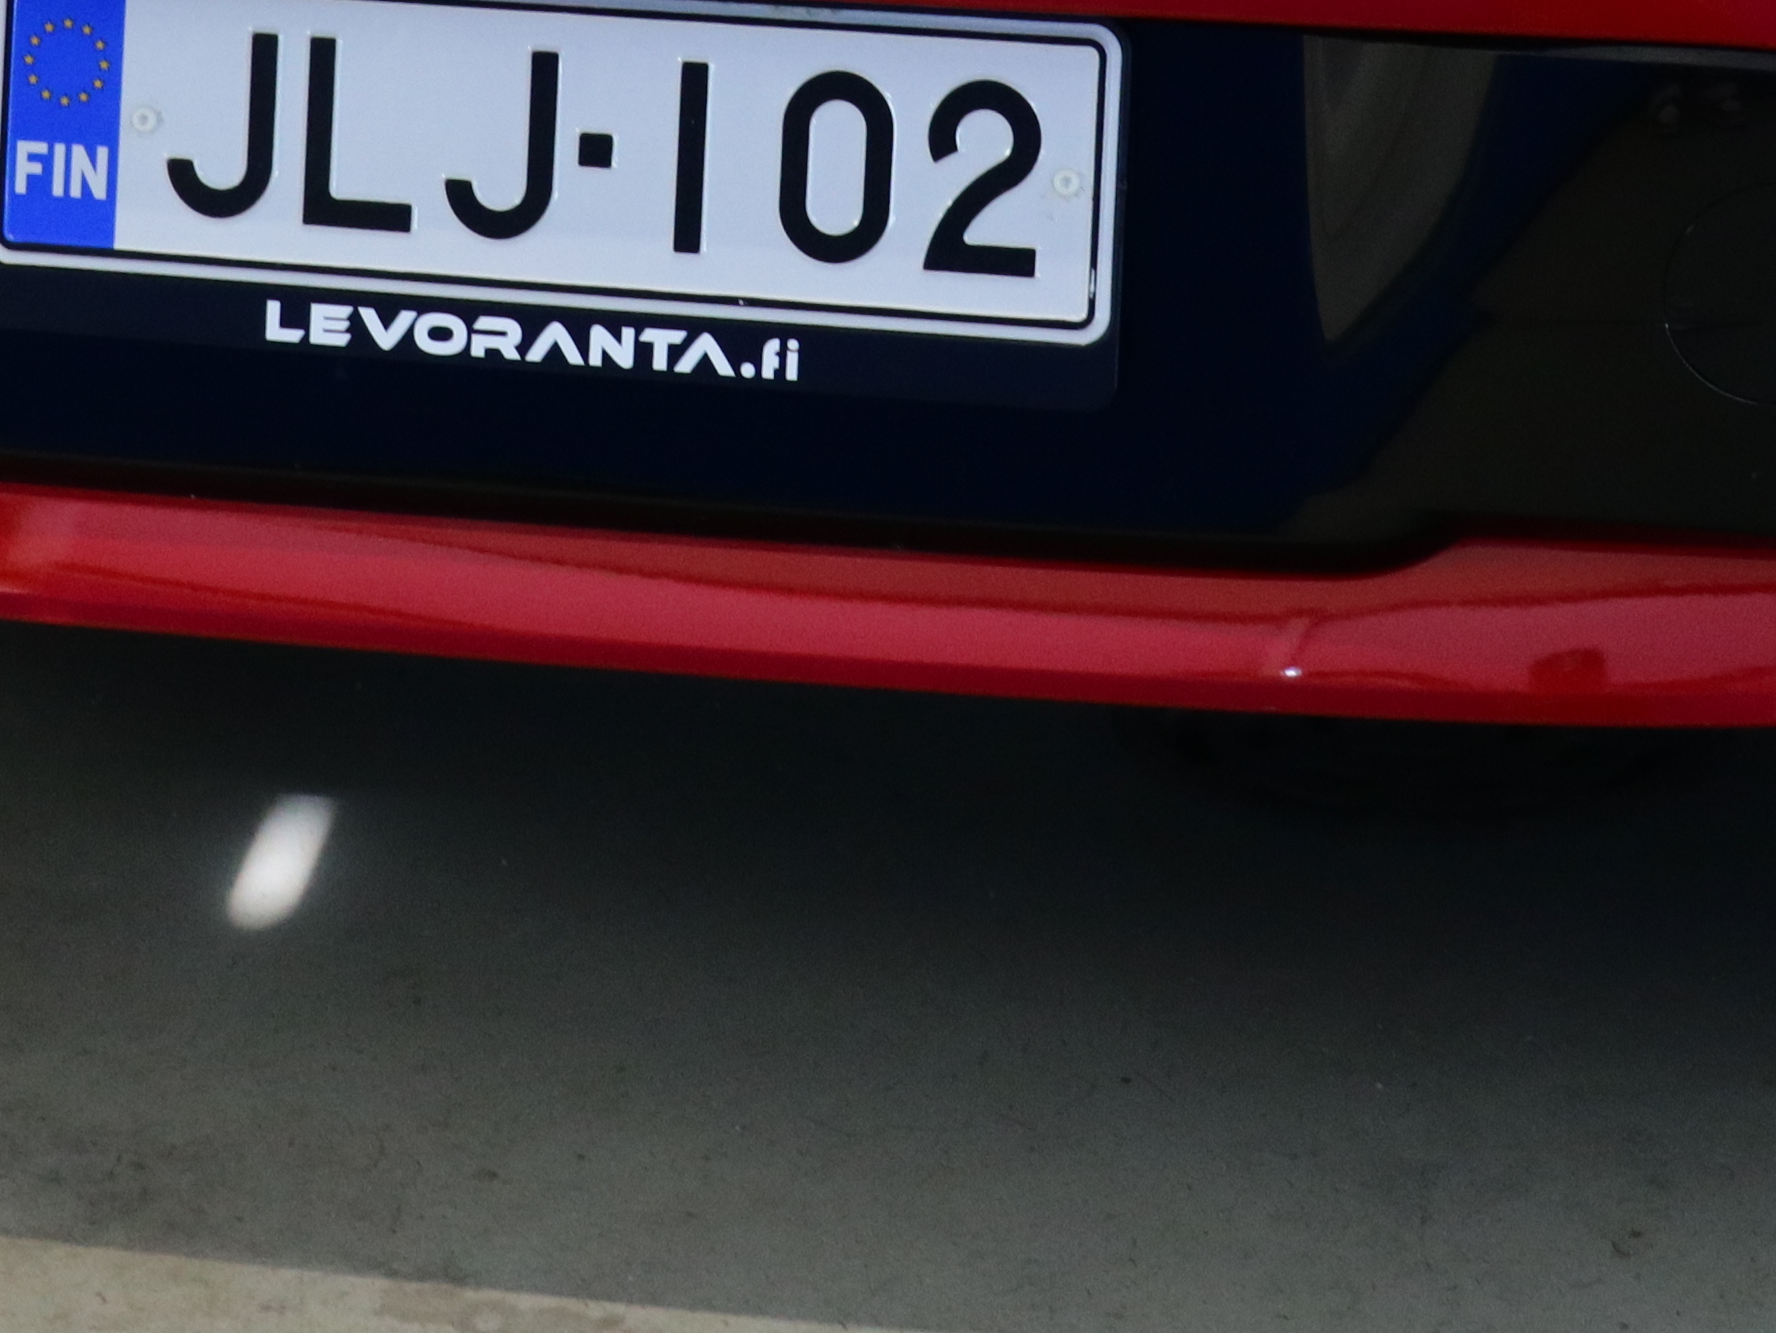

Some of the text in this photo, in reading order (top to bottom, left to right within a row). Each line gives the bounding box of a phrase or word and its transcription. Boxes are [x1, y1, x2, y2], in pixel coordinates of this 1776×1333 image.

[14, 139, 109, 200] FIN
[165, 31, 1044, 279] JLJ-102
[265, 298, 800, 382] LEVORANTA.fi
